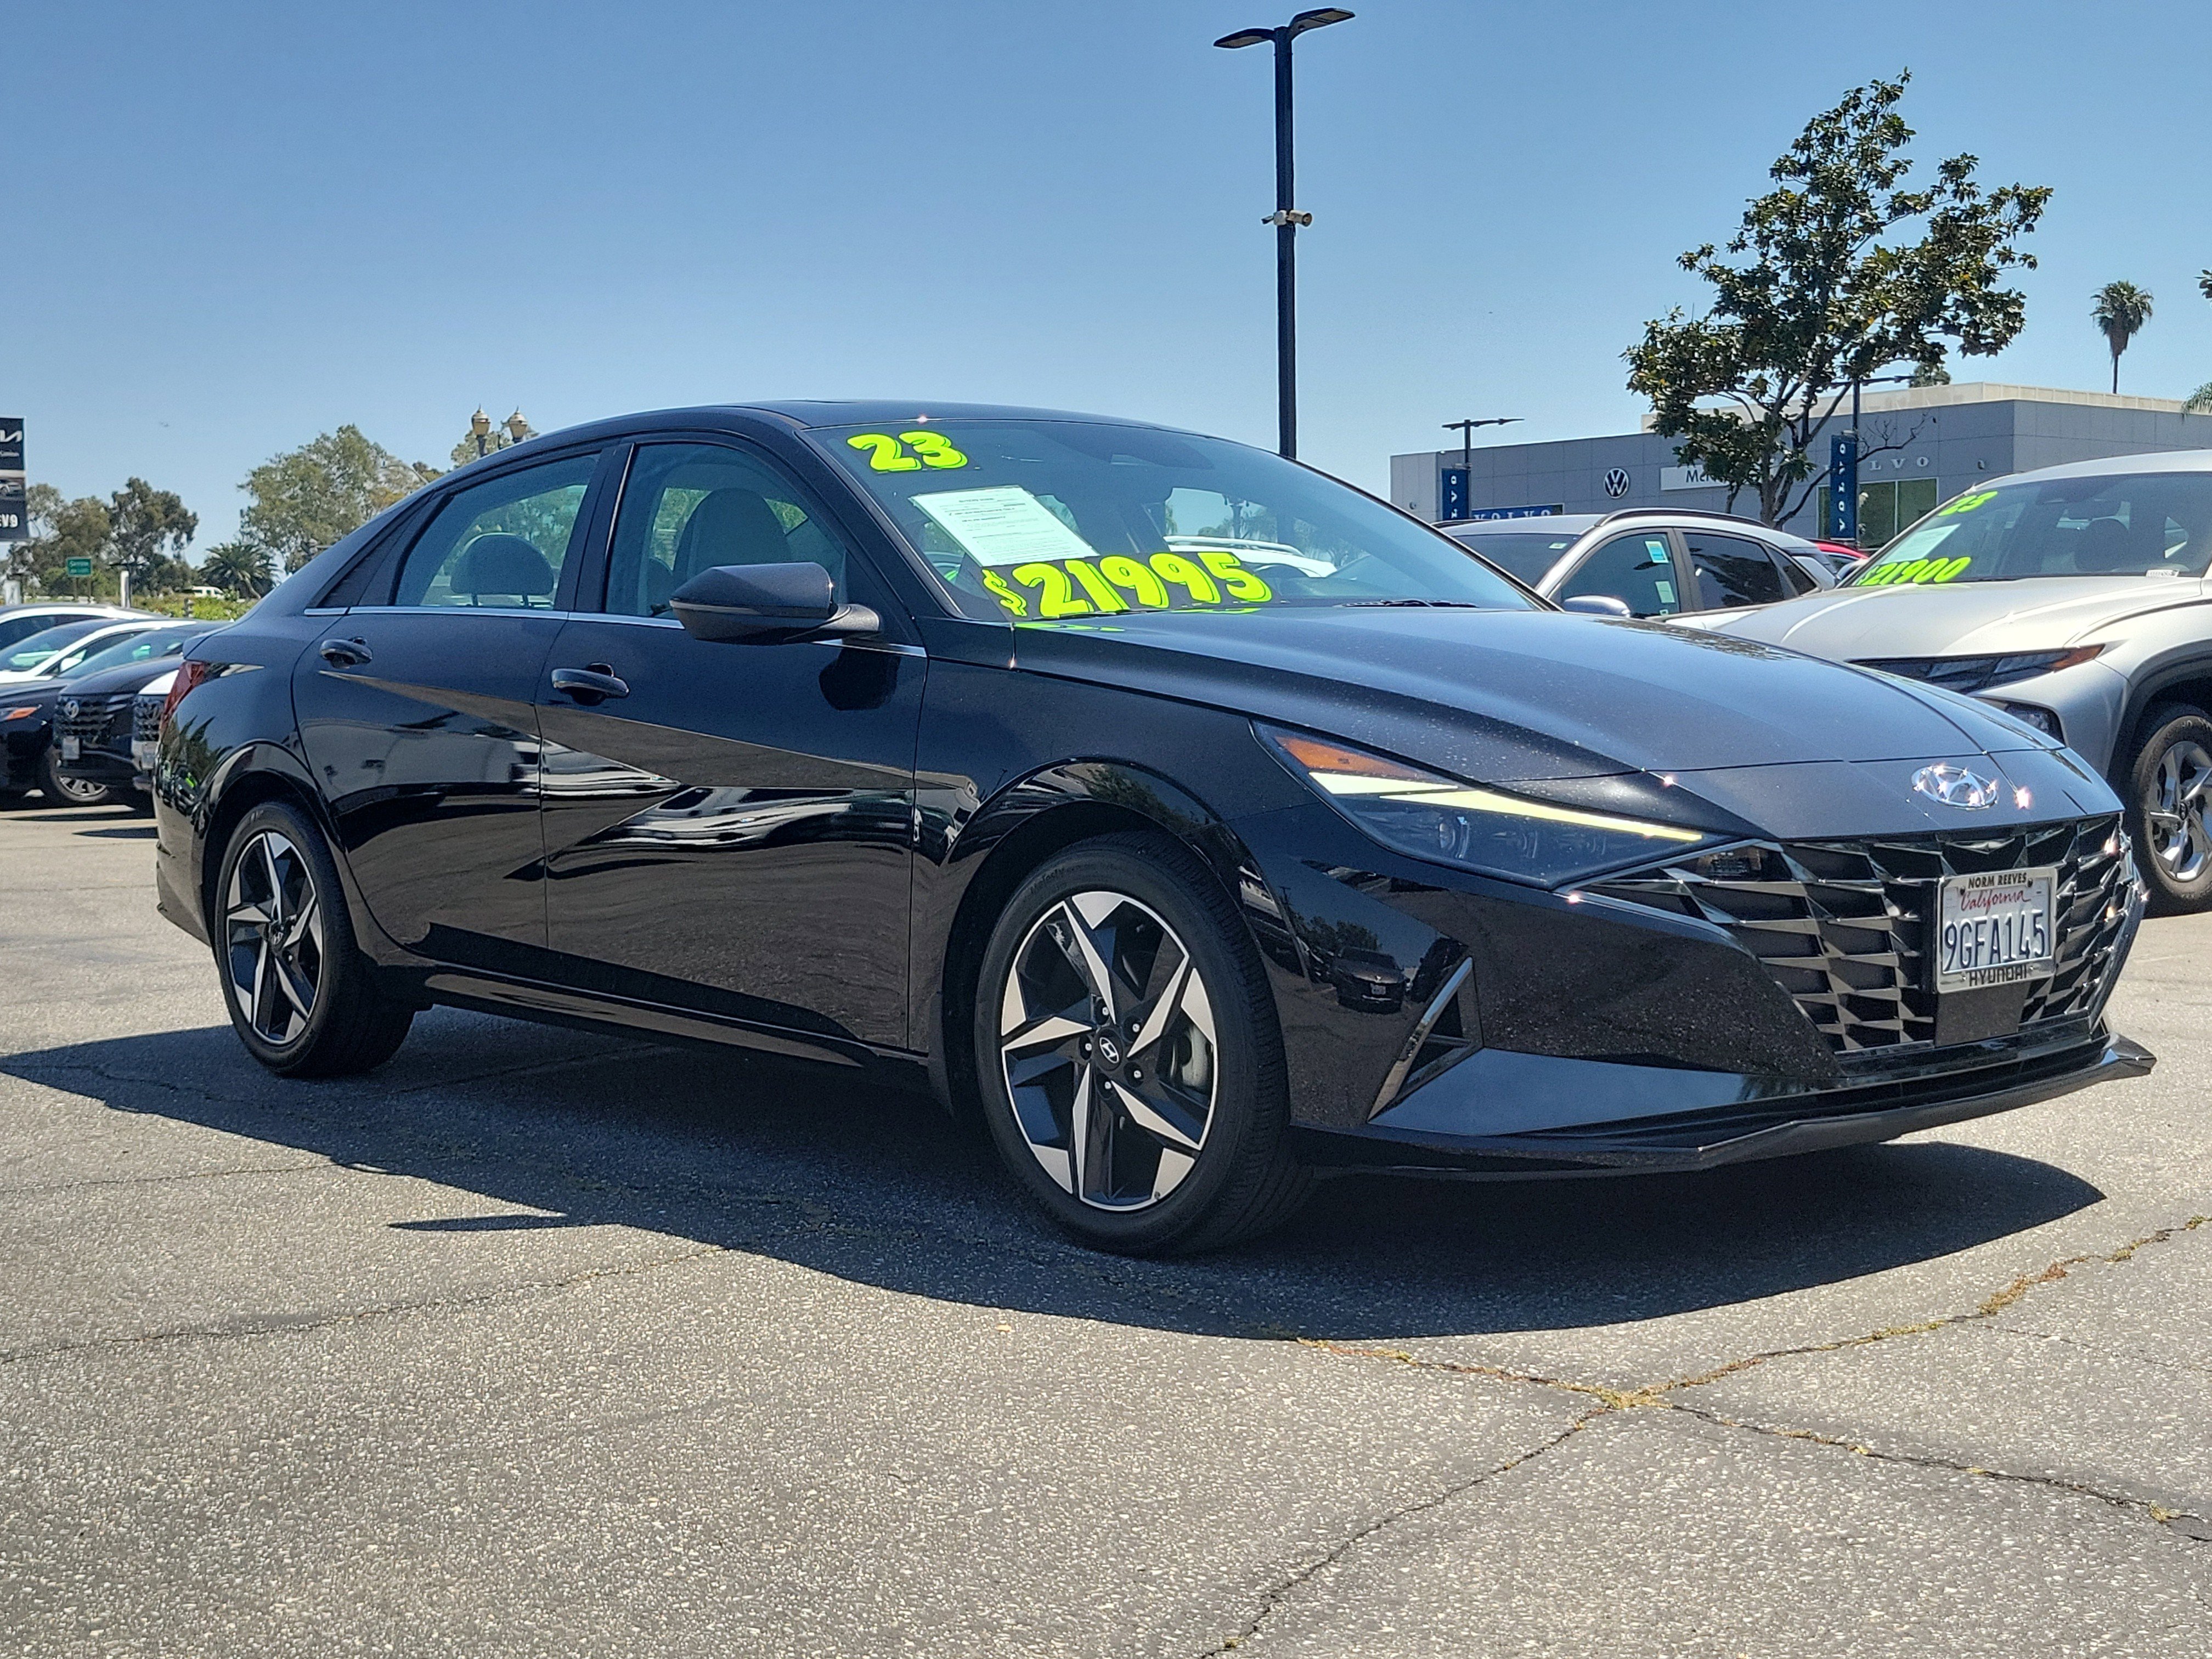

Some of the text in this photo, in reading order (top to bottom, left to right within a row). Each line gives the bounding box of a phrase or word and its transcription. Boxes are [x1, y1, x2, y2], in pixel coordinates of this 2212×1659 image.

[847, 431, 968, 472] 23
[1869, 456, 1929, 471] LVO
[983, 552, 1273, 618] $21995
[1968, 872, 2027, 889] NORM REEVES
[1960, 889, 2032, 915] California
[1943, 909, 2045, 972] 9GFA145
[1969, 964, 2027, 986] HYUNDAI
